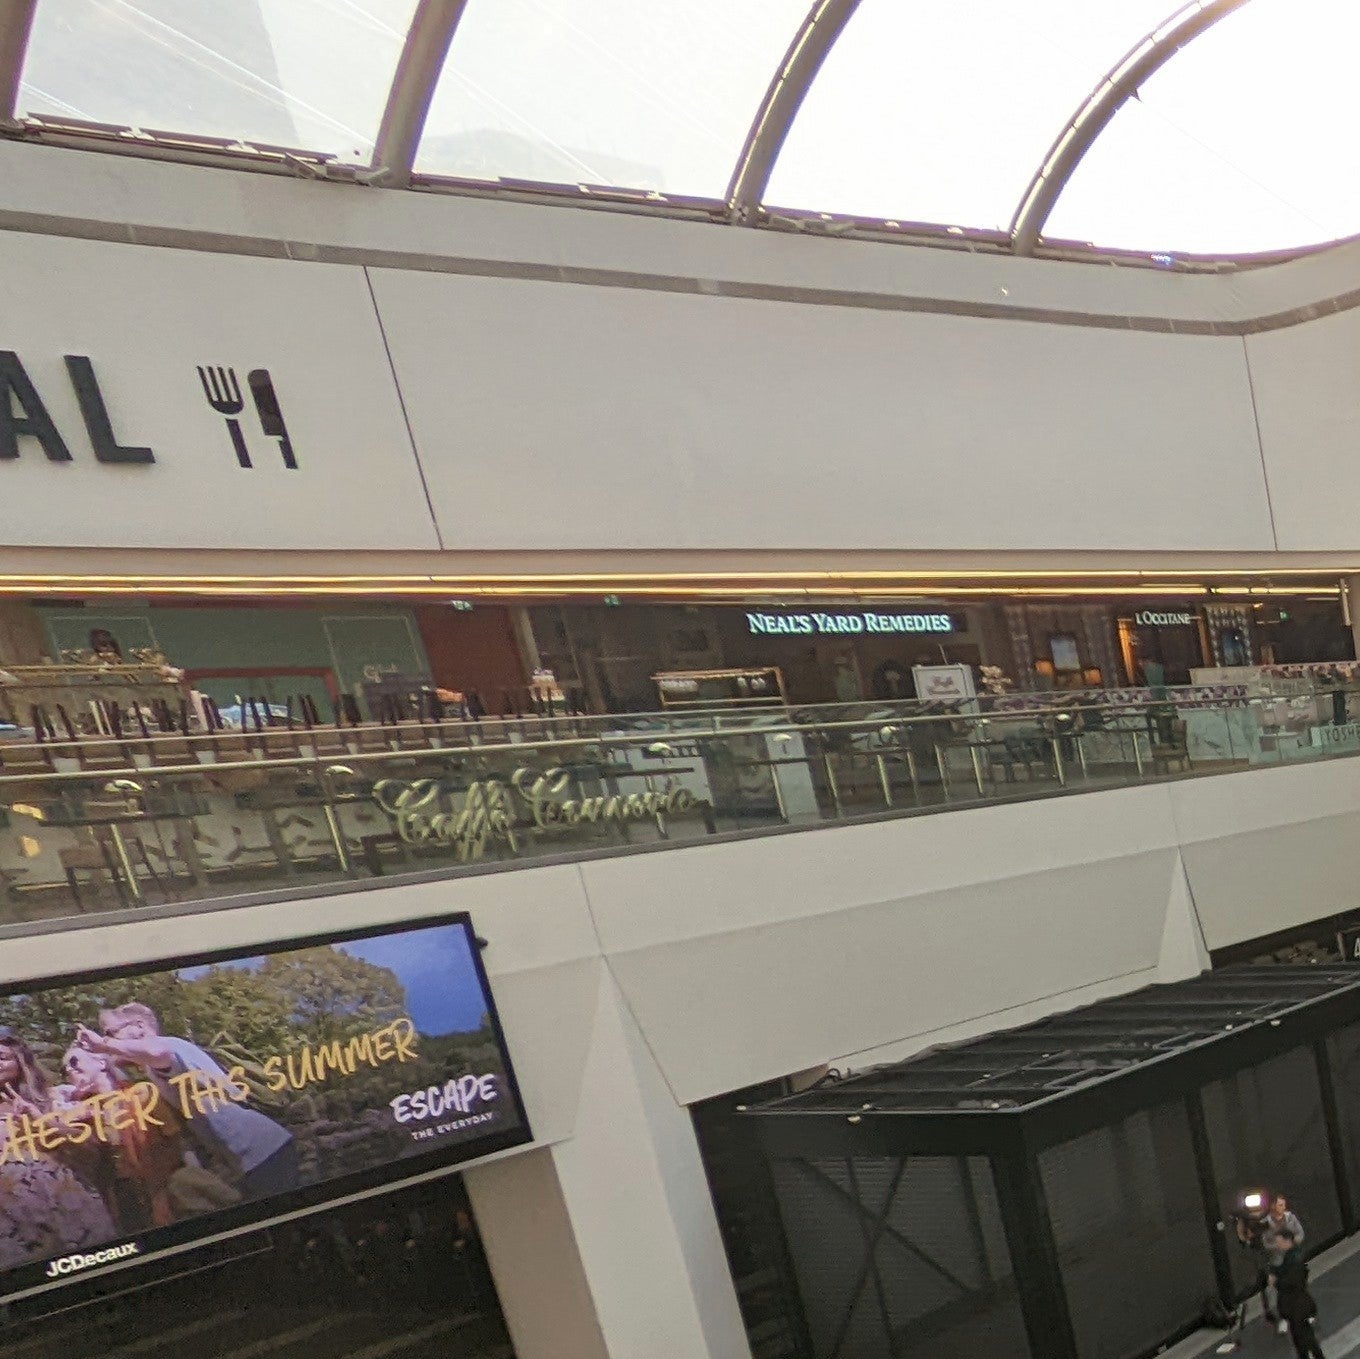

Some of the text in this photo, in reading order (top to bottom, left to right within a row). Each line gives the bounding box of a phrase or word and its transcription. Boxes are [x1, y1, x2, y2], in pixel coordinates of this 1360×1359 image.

[745, 612, 950, 634] NEAL'S YARD REMEDIES
[0, 1018, 420, 1163] HESTER THIS SUMMER
[390, 1072, 499, 1125] ESCAPE
[437, 1112, 494, 1137] EVERYDAY
[45, 1240, 140, 1279] JCDecaux
